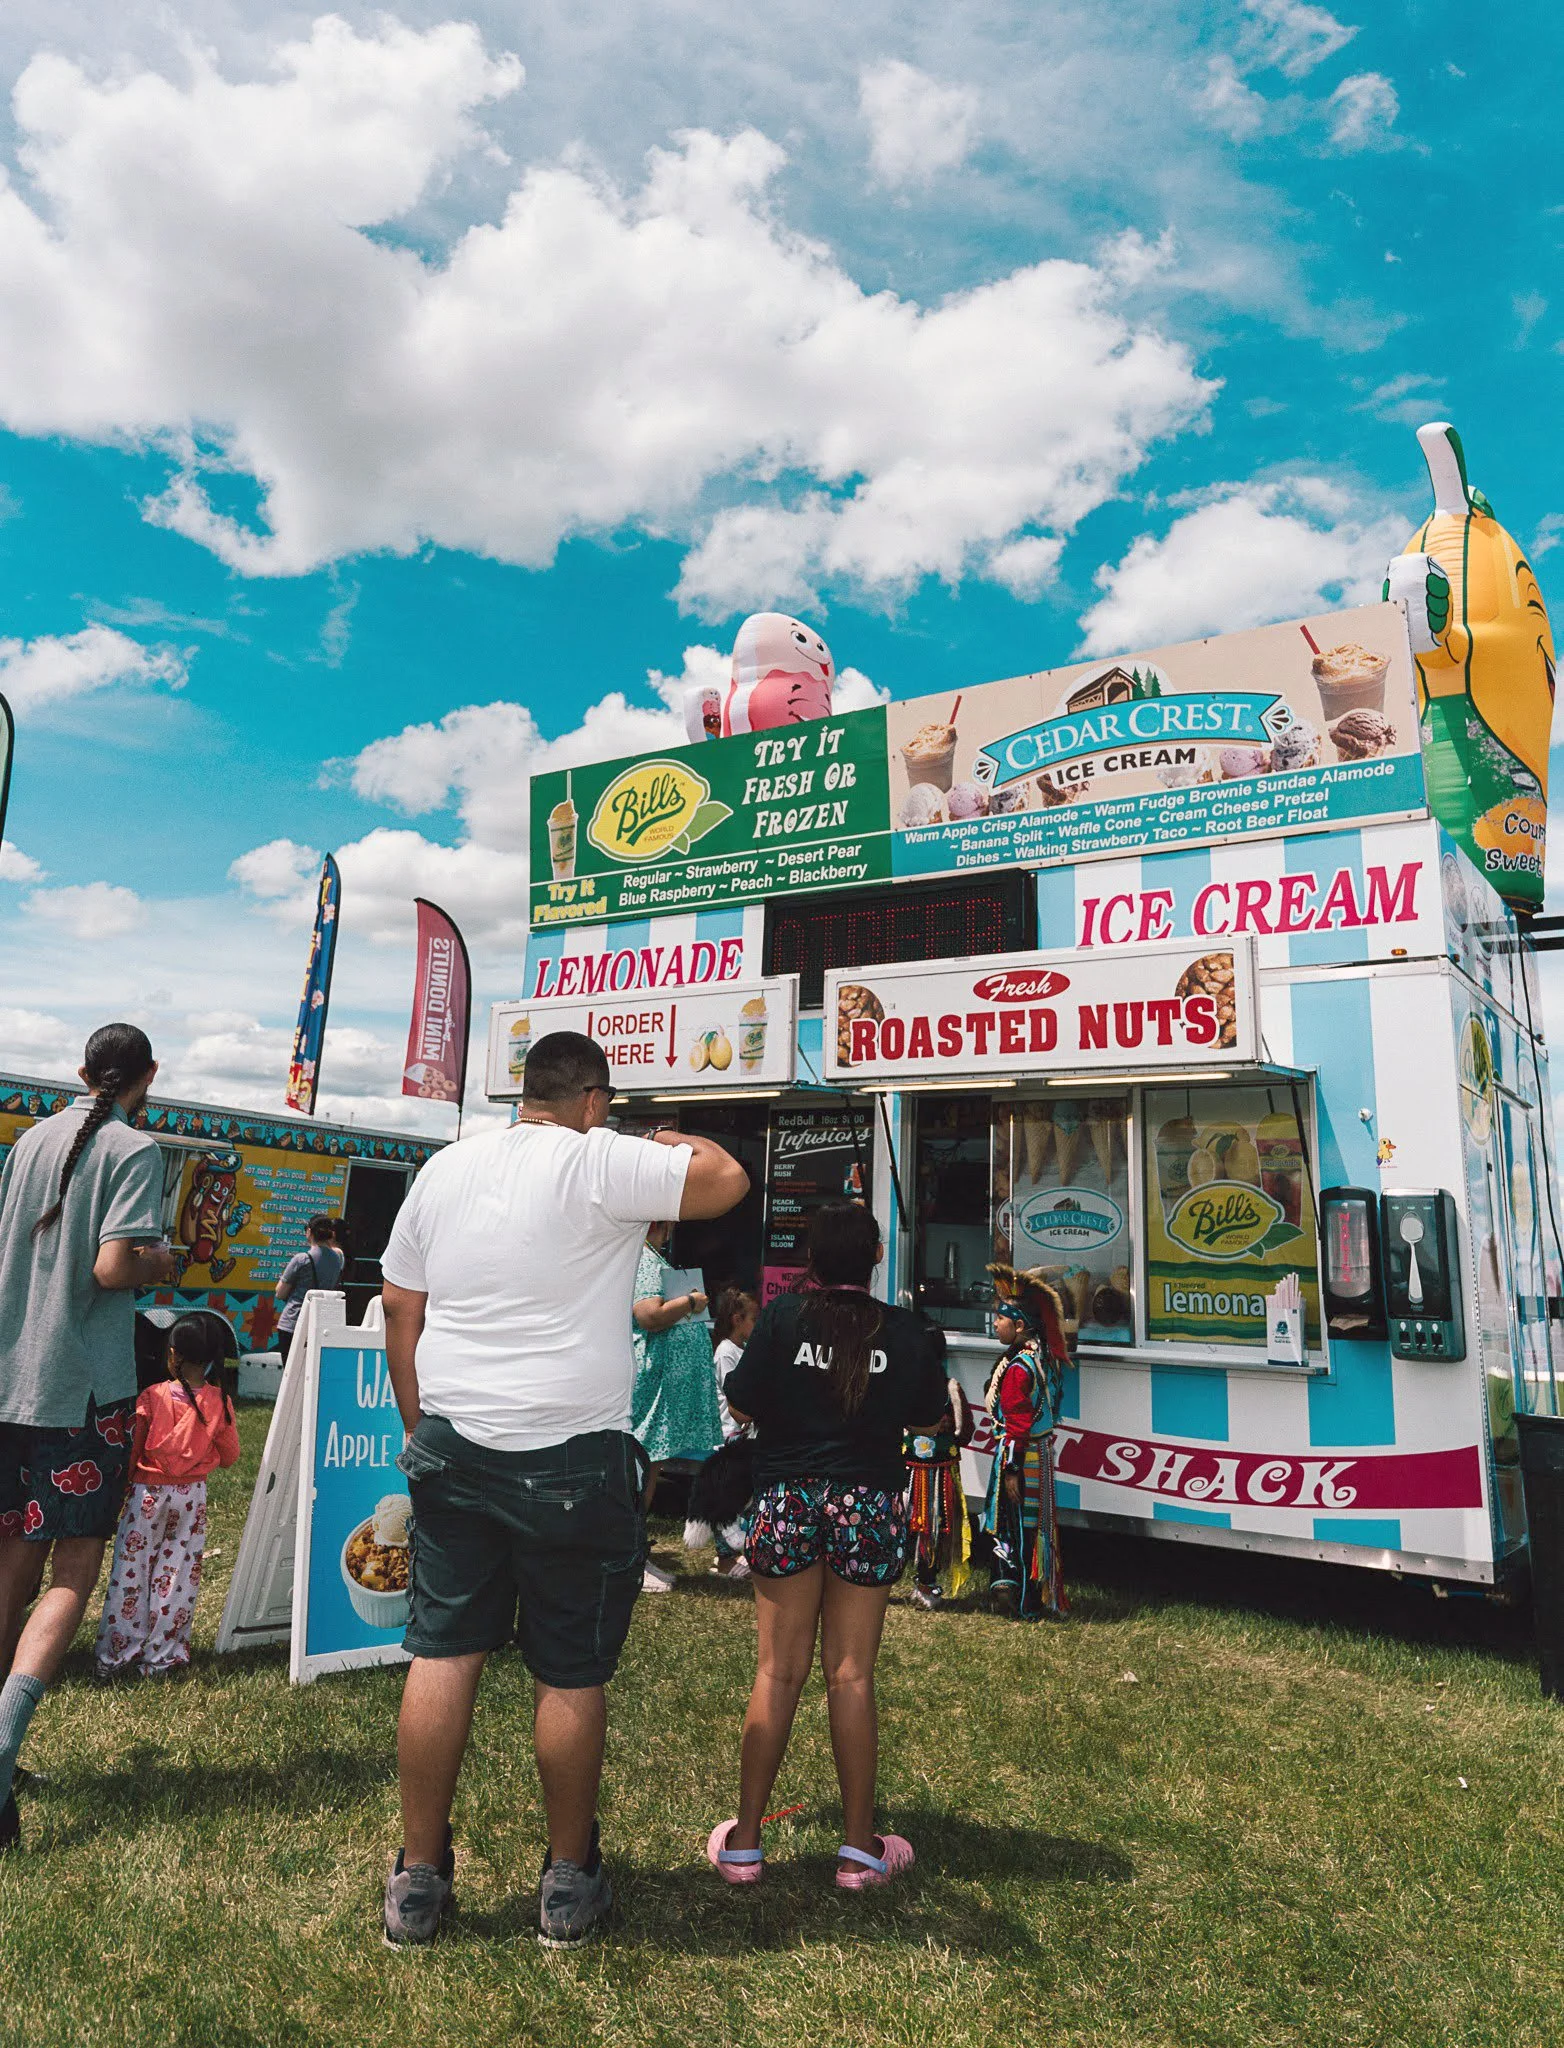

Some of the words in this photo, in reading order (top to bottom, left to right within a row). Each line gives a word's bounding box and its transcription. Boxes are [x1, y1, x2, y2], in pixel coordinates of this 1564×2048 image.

[754, 735, 808, 768] TRY
[1005, 713, 1124, 770] CEDAR
[1128, 702, 1252, 737] CREST
[741, 770, 815, 805] FRESH
[824, 762, 857, 791] OR
[1056, 760, 1095, 785] ICE
[1103, 748, 1196, 772] CREAM
[612, 773, 686, 847] Bill's
[752, 800, 849, 839] FROZEN
[905, 831, 939, 844] Warm
[942, 824, 978, 840] Apple
[982, 819, 1016, 834] Crisp
[1019, 810, 1078, 828] Alamode
[1094, 801, 1135, 817] Warm
[1139, 794, 1185, 811] Fudge
[1189, 784, 1252, 804] Brownie
[1256, 774, 1316, 794] Sundae
[1320, 762, 1395, 784] Alamode
[962, 836, 1009, 851] Banana
[1013, 828, 1043, 845] Split
[1058, 819, 1100, 838] Waffle
[1104, 816, 1142, 831] Cone
[1159, 807, 1207, 823] Cream
[1212, 799, 1269, 816] Cheese
[1273, 788, 1329, 808] Pretzel
[649, 825, 675, 835] WORLD
[956, 851, 1000, 867] Dishes
[1015, 843, 1067, 860] Walking
[1071, 831, 1149, 852] Strawberry
[1152, 826, 1188, 840] Taco
[1205, 817, 1242, 834] Root
[1246, 813, 1283, 829] Beer
[1287, 805, 1328, 823] Float
[618, 892, 646, 906] Blue
[650, 884, 716, 902] Raspberry
[731, 874, 773, 892] Peach
[789, 863, 868, 885] Blackberry
[623, 871, 672, 889] Regular
[685, 860, 758, 880] Strawberry
[777, 847, 825, 867] Desert
[827, 844, 862, 860] Pear
[533, 896, 607, 923] Flavored
[547, 882, 578, 903] Try
[580, 878, 595, 897] It
[1077, 890, 1174, 947] ICE
[1193, 861, 1423, 936] CREAM
[533, 938, 744, 999] LEMONADE
[985, 971, 1052, 1001] Fresh
[597, 1011, 664, 1037] ORDER
[850, 1008, 1058, 1062] ROASTED
[1078, 997, 1219, 1050] NUTS
[604, 1043, 655, 1066] HERE
[1049, 1228, 1062, 1237] ICE
[1063, 1228, 1090, 1237] CREAM
[1188, 1193, 1261, 1246] Bill's
[1163, 1282, 1267, 1318] lemona
[356, 1349, 397, 1409] WA
[323, 1420, 392, 1468] APPLE
[1097, 1441, 1357, 1508] SHACK
